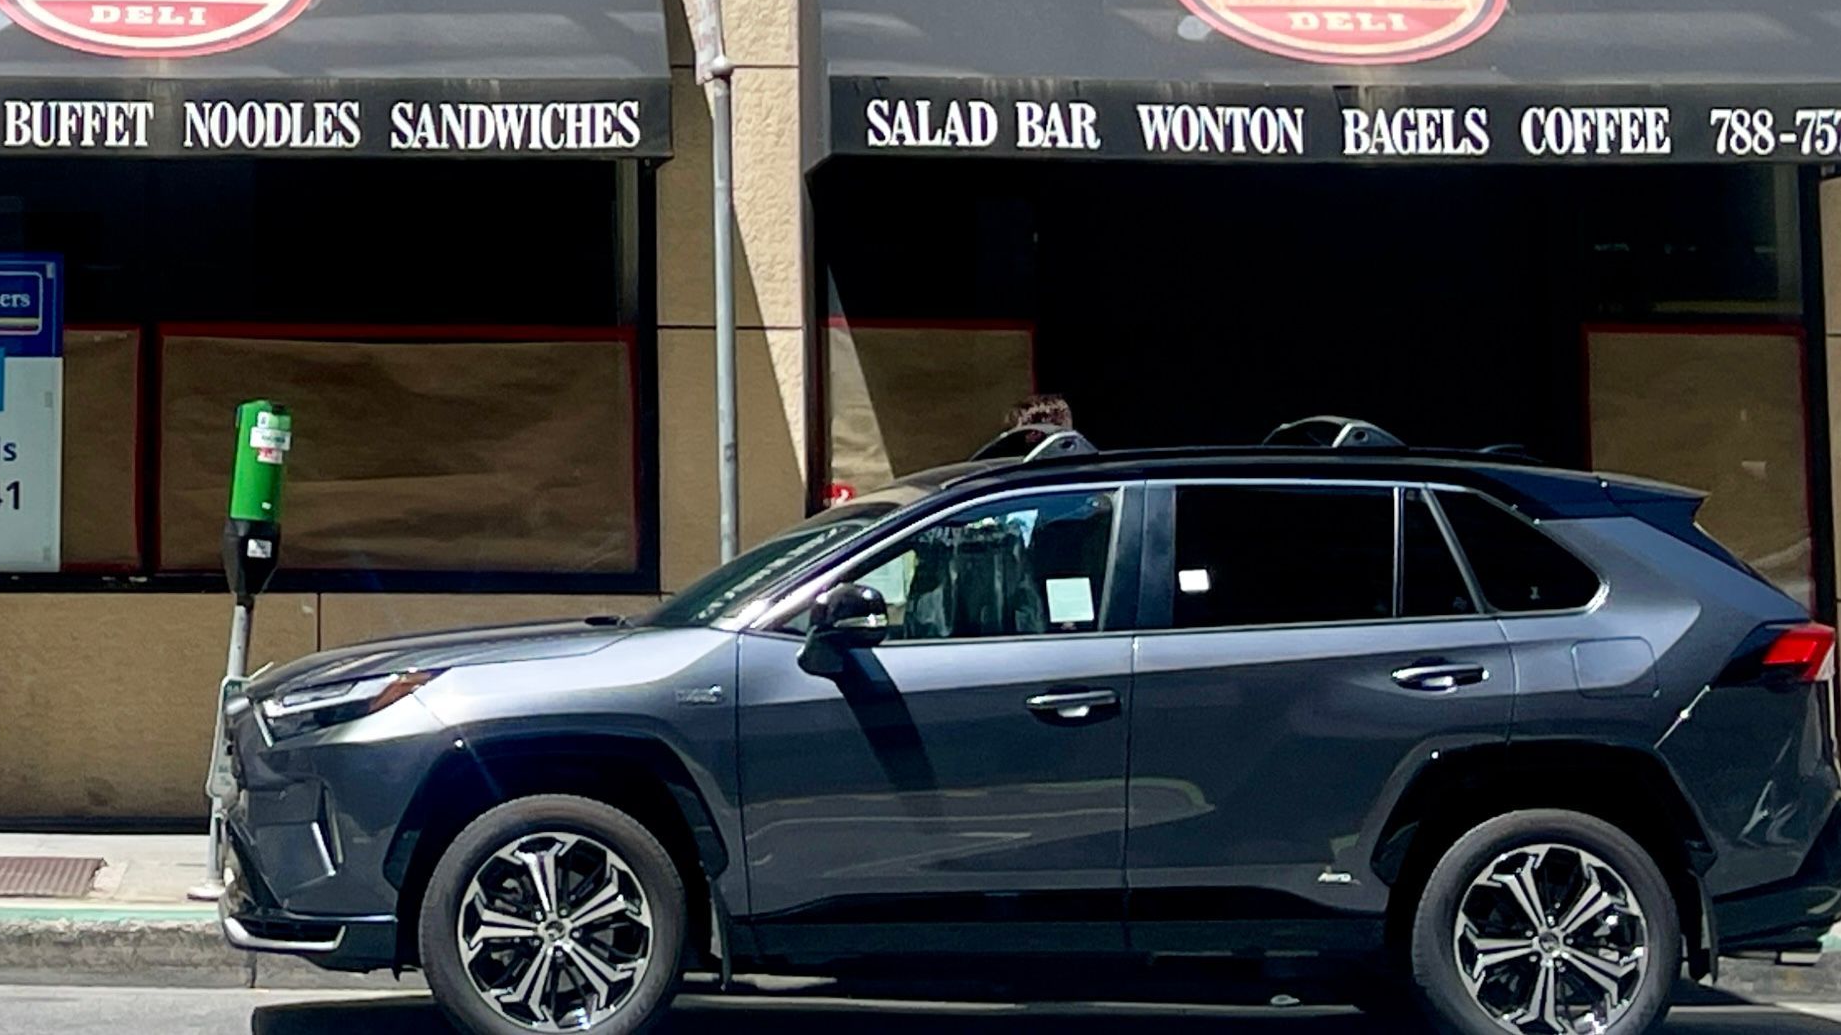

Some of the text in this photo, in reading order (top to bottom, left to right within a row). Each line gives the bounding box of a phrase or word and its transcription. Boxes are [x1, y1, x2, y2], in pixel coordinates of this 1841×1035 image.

[89, 5, 207, 26] DELI
[1286, 11, 1409, 32] DELI
[5, 100, 155, 147] BUFFET
[183, 101, 361, 148] NOODLES
[390, 100, 641, 149] SANDWICHES
[866, 99, 999, 148] SALAD
[1015, 101, 1101, 150] BAR
[1136, 104, 1304, 155] WONTON
[1342, 106, 1490, 156] BAGELS
[1520, 107, 1671, 155] COFFEE
